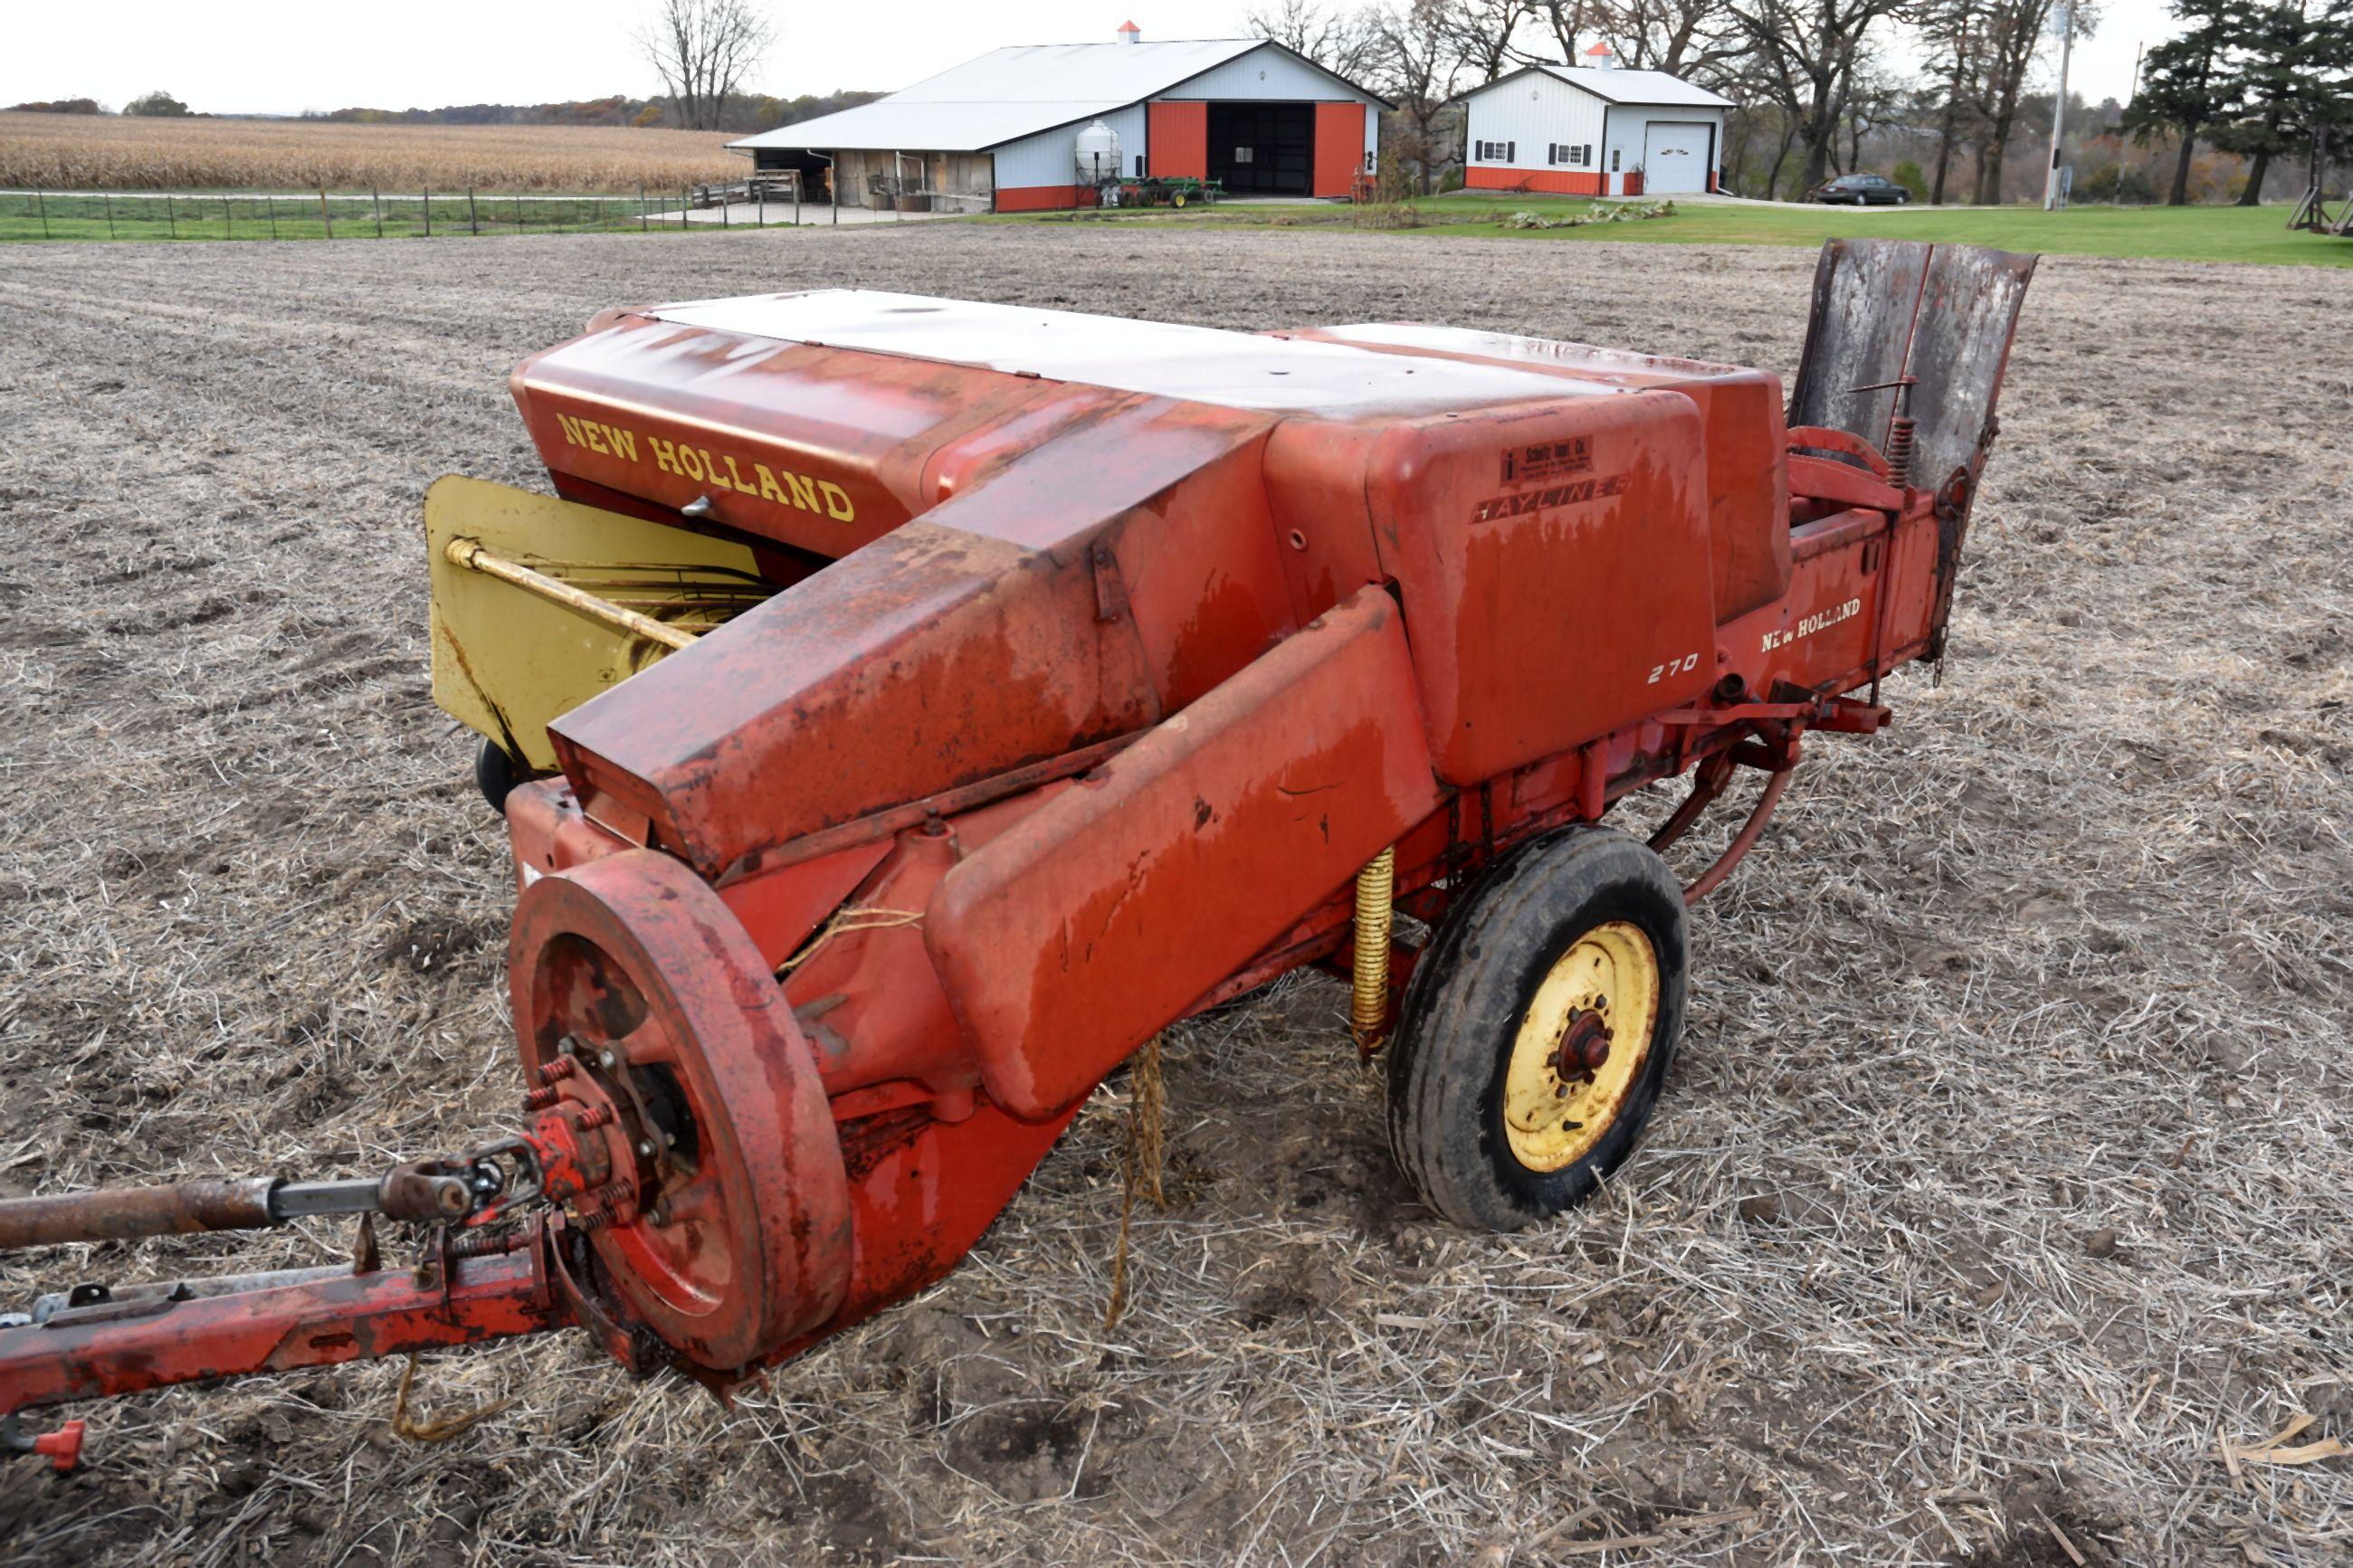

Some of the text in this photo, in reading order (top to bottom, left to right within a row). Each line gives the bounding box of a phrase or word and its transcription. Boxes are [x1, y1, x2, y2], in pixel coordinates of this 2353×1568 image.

[557, 413, 855, 523] NEW HOLLAND
[1470, 477, 1633, 523] HAYLINER
[1797, 598, 1861, 639] HOLLAND
[1647, 653, 1699, 685] 270
